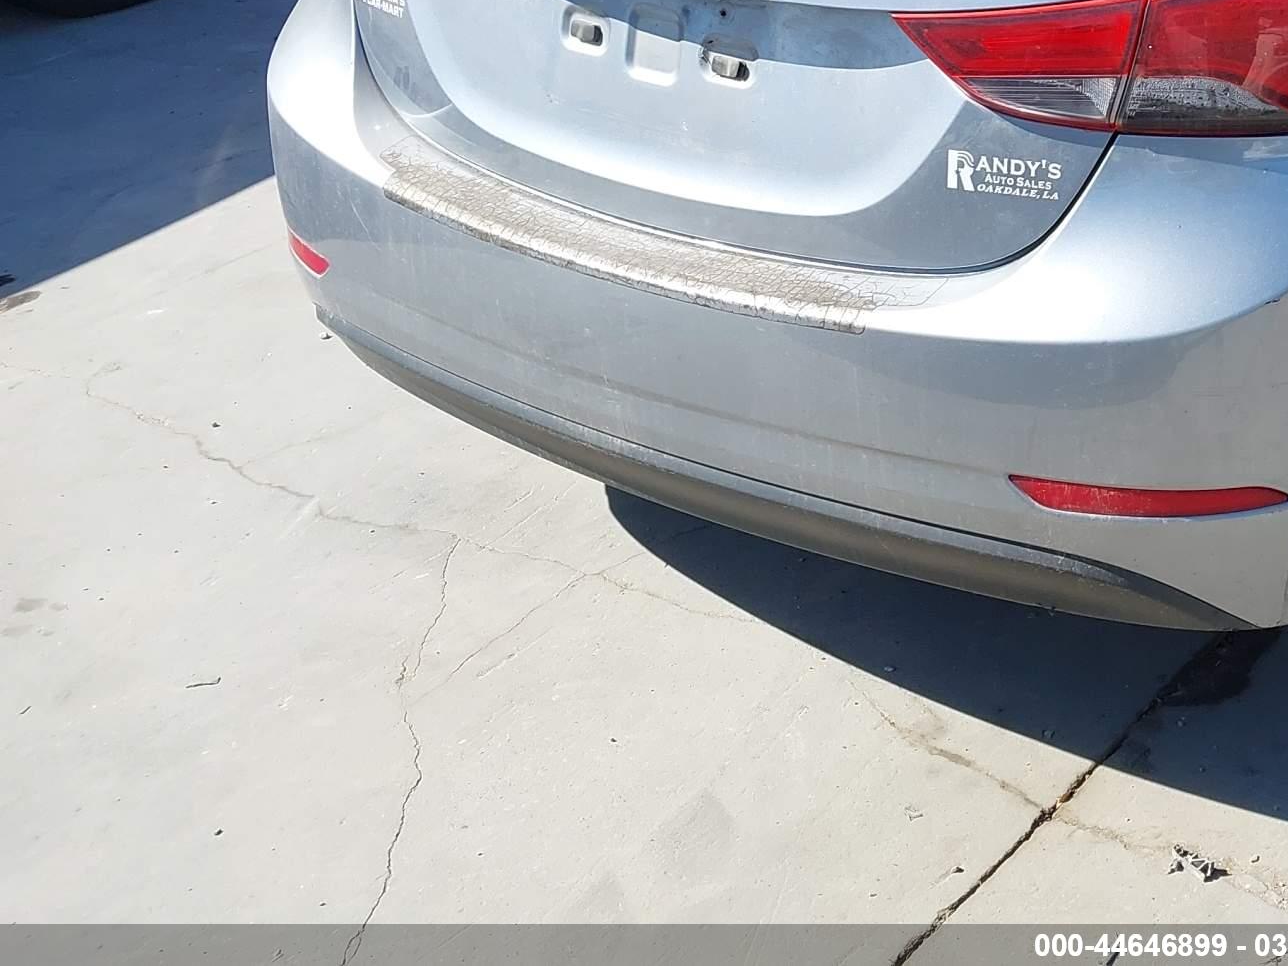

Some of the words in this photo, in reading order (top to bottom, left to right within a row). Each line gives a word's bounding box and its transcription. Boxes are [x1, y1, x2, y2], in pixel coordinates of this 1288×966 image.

[984, 173, 1014, 186] AUTO
[1016, 177, 1052, 190] SALES
[977, 183, 1040, 199] OAKDALE,
[1042, 191, 1059, 200] LA
